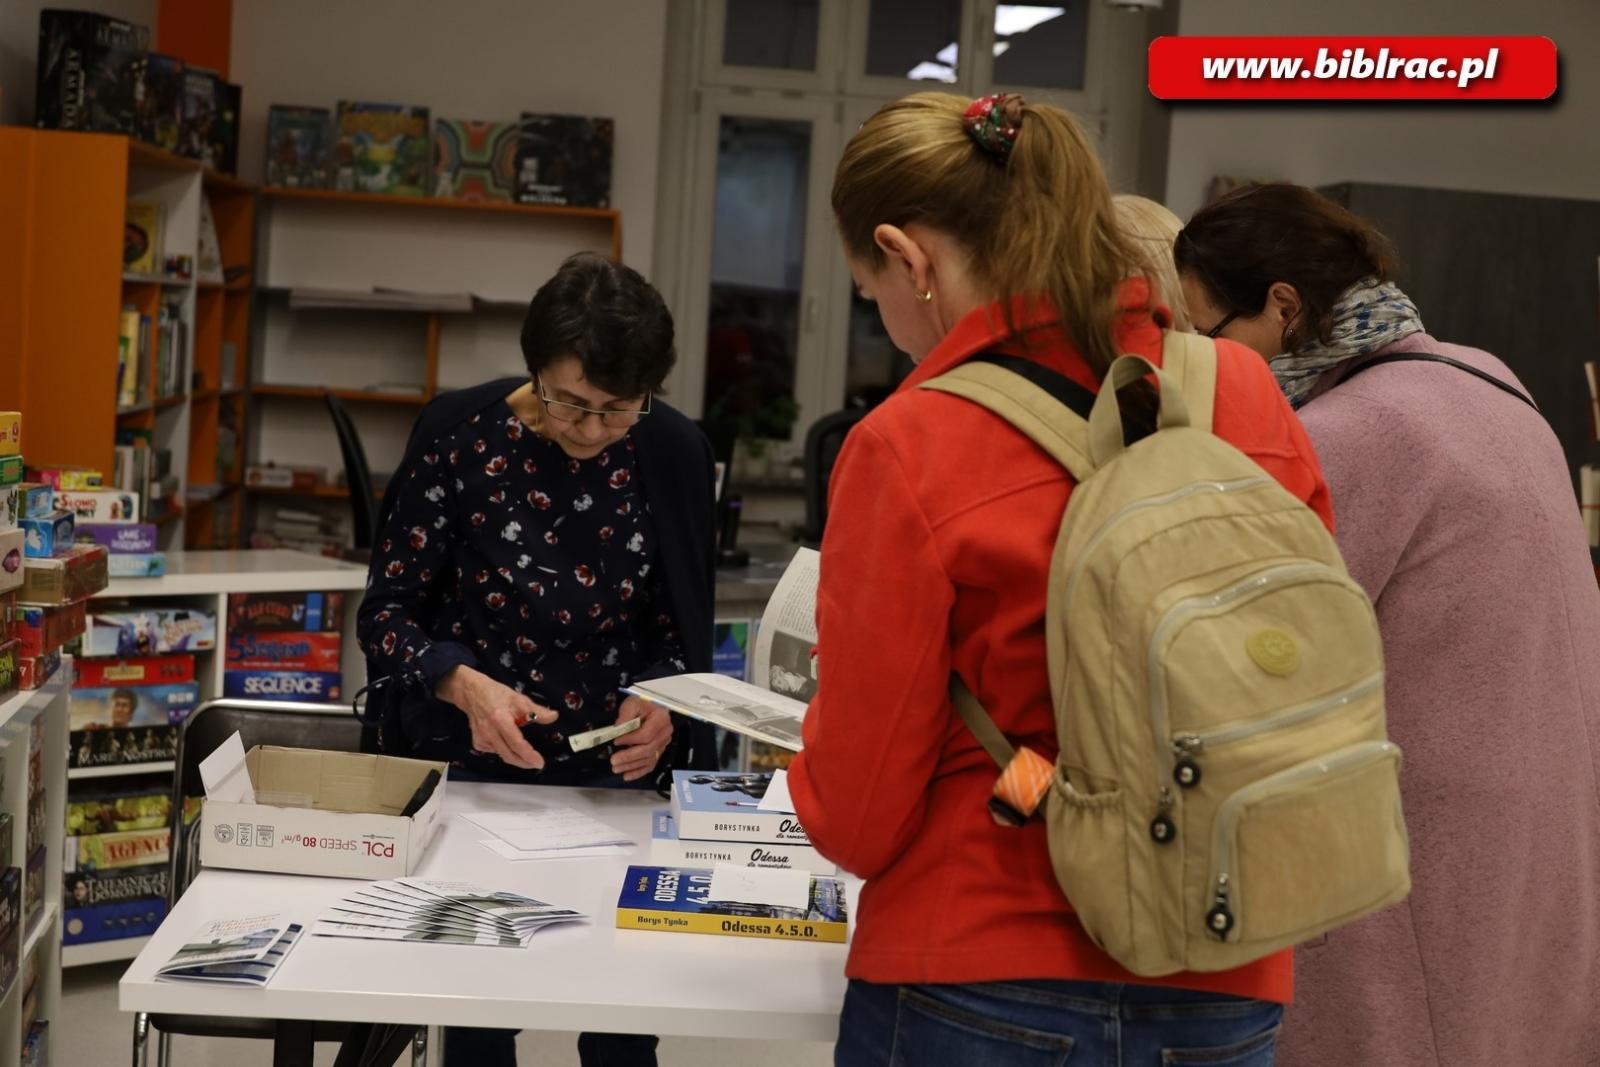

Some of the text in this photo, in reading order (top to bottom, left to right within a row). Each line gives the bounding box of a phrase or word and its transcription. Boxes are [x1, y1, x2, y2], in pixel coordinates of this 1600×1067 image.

[243, 677, 323, 695] SEQUENCE
[714, 823, 761, 832] BORYS TYNKA
[779, 819, 804, 833] Odes
[108, 834, 172, 860] AGENC
[302, 836, 317, 848] 80
[320, 838, 358, 851] SPEED
[362, 840, 394, 858] POL
[686, 852, 732, 861] BORYS TYNKA
[750, 848, 789, 863] Odessa
[653, 870, 681, 902] ODESSA
[638, 916, 818, 938] Borys Tynka Odessa 4.5.0.
